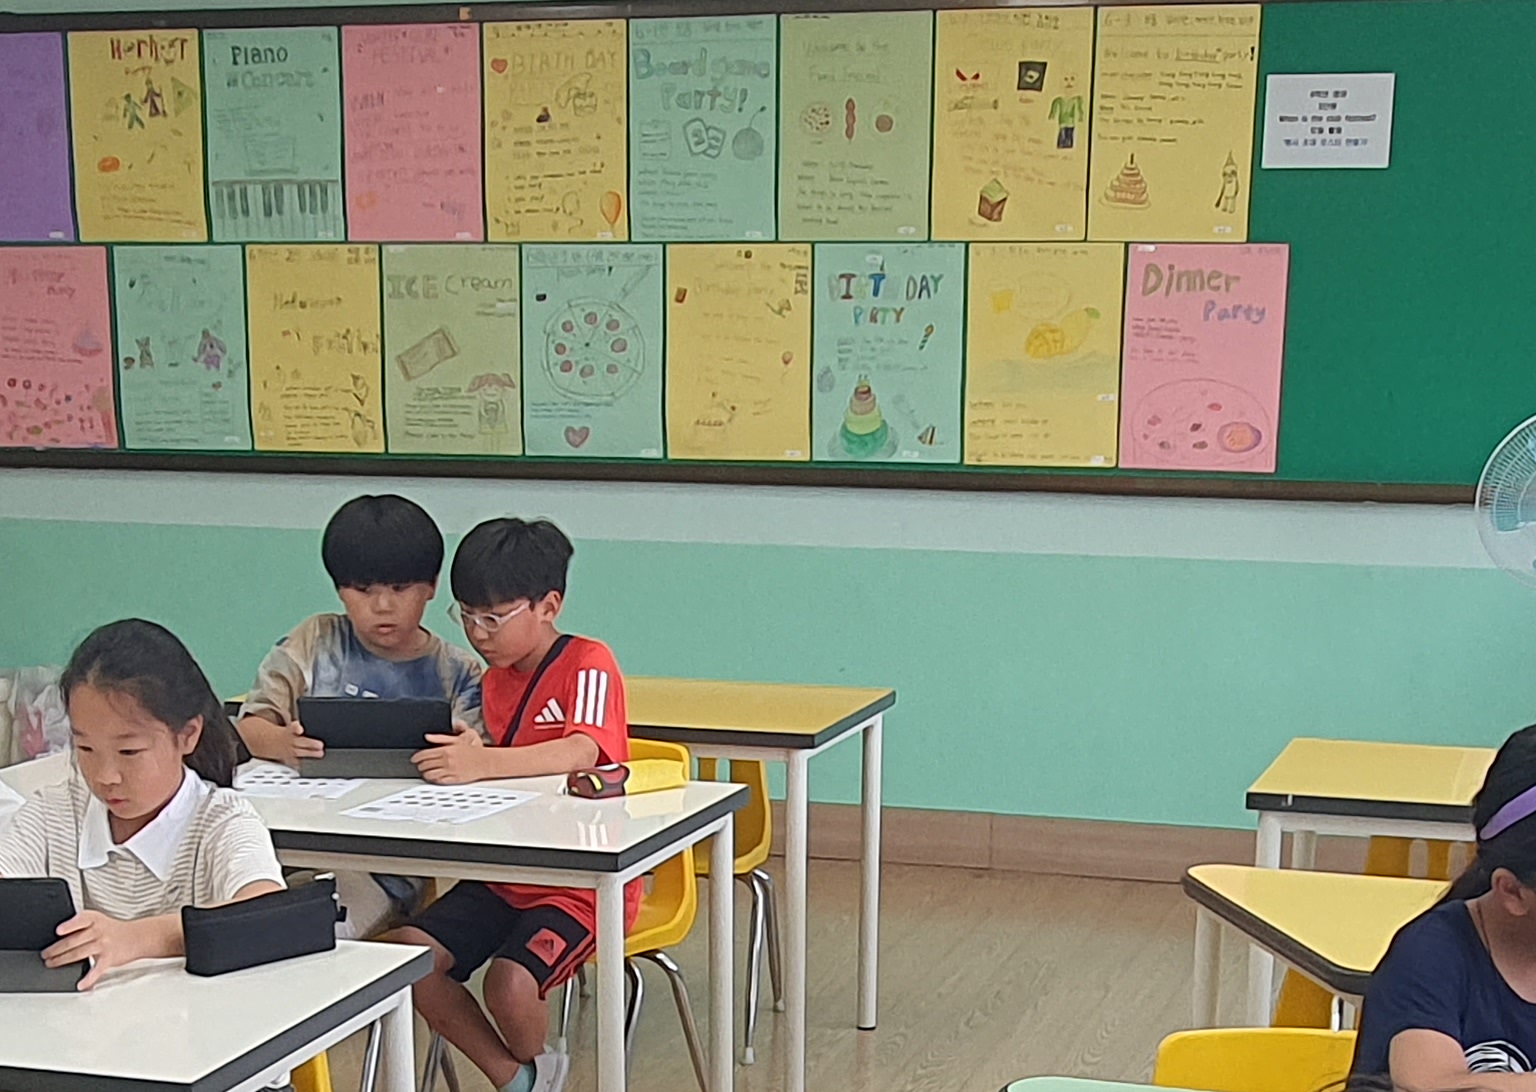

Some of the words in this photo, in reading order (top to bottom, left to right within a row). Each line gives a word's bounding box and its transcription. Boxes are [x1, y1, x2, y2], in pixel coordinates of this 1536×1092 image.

[230, 44, 290, 67] Piano
[633, 47, 707, 80] Board
[660, 82, 748, 113] Party!
[386, 273, 440, 300] ICE
[444, 274, 514, 296] Cream
[904, 272, 945, 302] DAY
[1141, 262, 1242, 298] Dinner
[1202, 299, 1267, 326] Party
